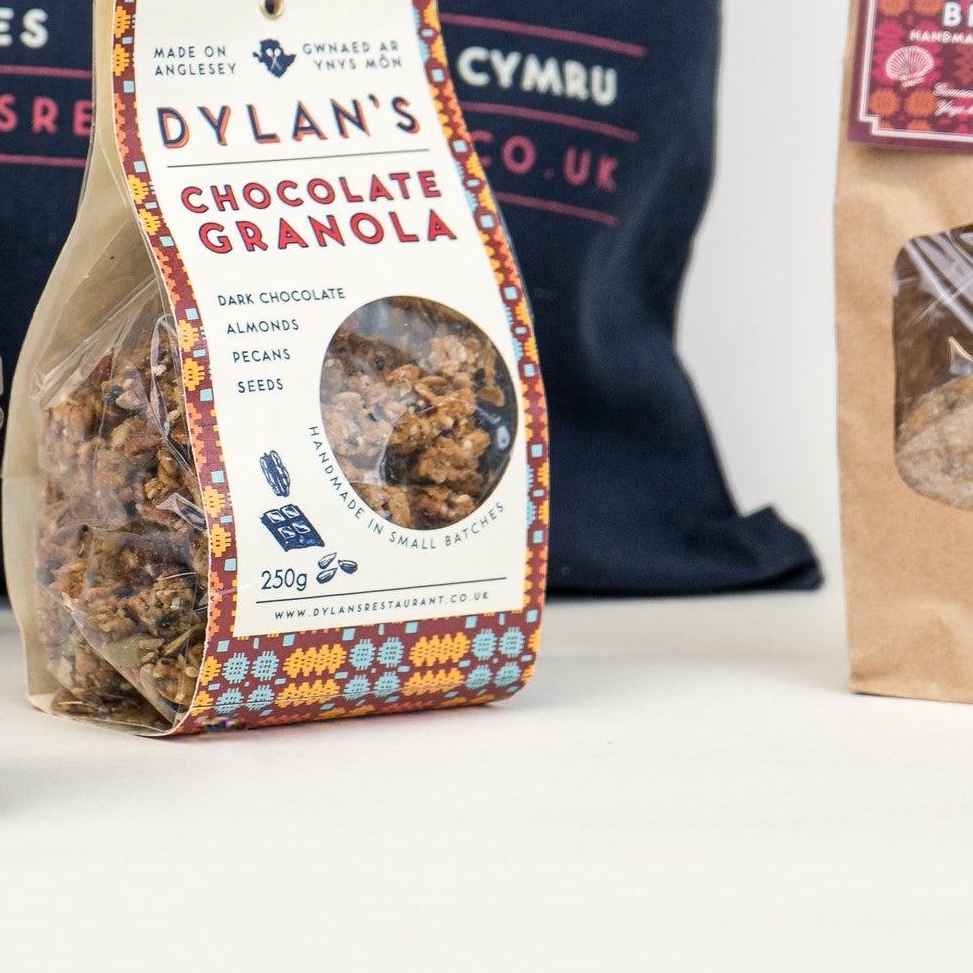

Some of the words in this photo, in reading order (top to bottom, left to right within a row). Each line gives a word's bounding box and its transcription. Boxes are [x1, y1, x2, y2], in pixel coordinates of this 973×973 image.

[154, 45, 196, 59] MADE
[204, 45, 227, 58] ON
[302, 42, 370, 55] GWNAED
[379, 40, 399, 52] AR
[155, 62, 237, 76] ANGLESEY
[314, 58, 357, 71] YNYS
[365, 54, 402, 69] MÔN
[457, 45, 618, 107] CYMRU
[157, 93, 420, 149] DYLAN'S
[180, 170, 442, 214] CHOCOLATE
[198, 208, 458, 255] GRANOLA
[217, 292, 255, 307] DARK
[259, 287, 346, 304] CHOCOLATE
[226, 318, 300, 335] ALMONDS
[232, 348, 291, 364] PECANS
[237, 377, 284, 394] SEEDS
[308, 426, 365, 521] HANDMADE
[367, 518, 384, 536] IN
[389, 530, 437, 550] SMALL
[444, 501, 506, 547] BATCHES
[260, 568, 308, 592] 250g
[274, 590, 490, 620] WWW.DYLANSRESTAURANT.CO.UK
